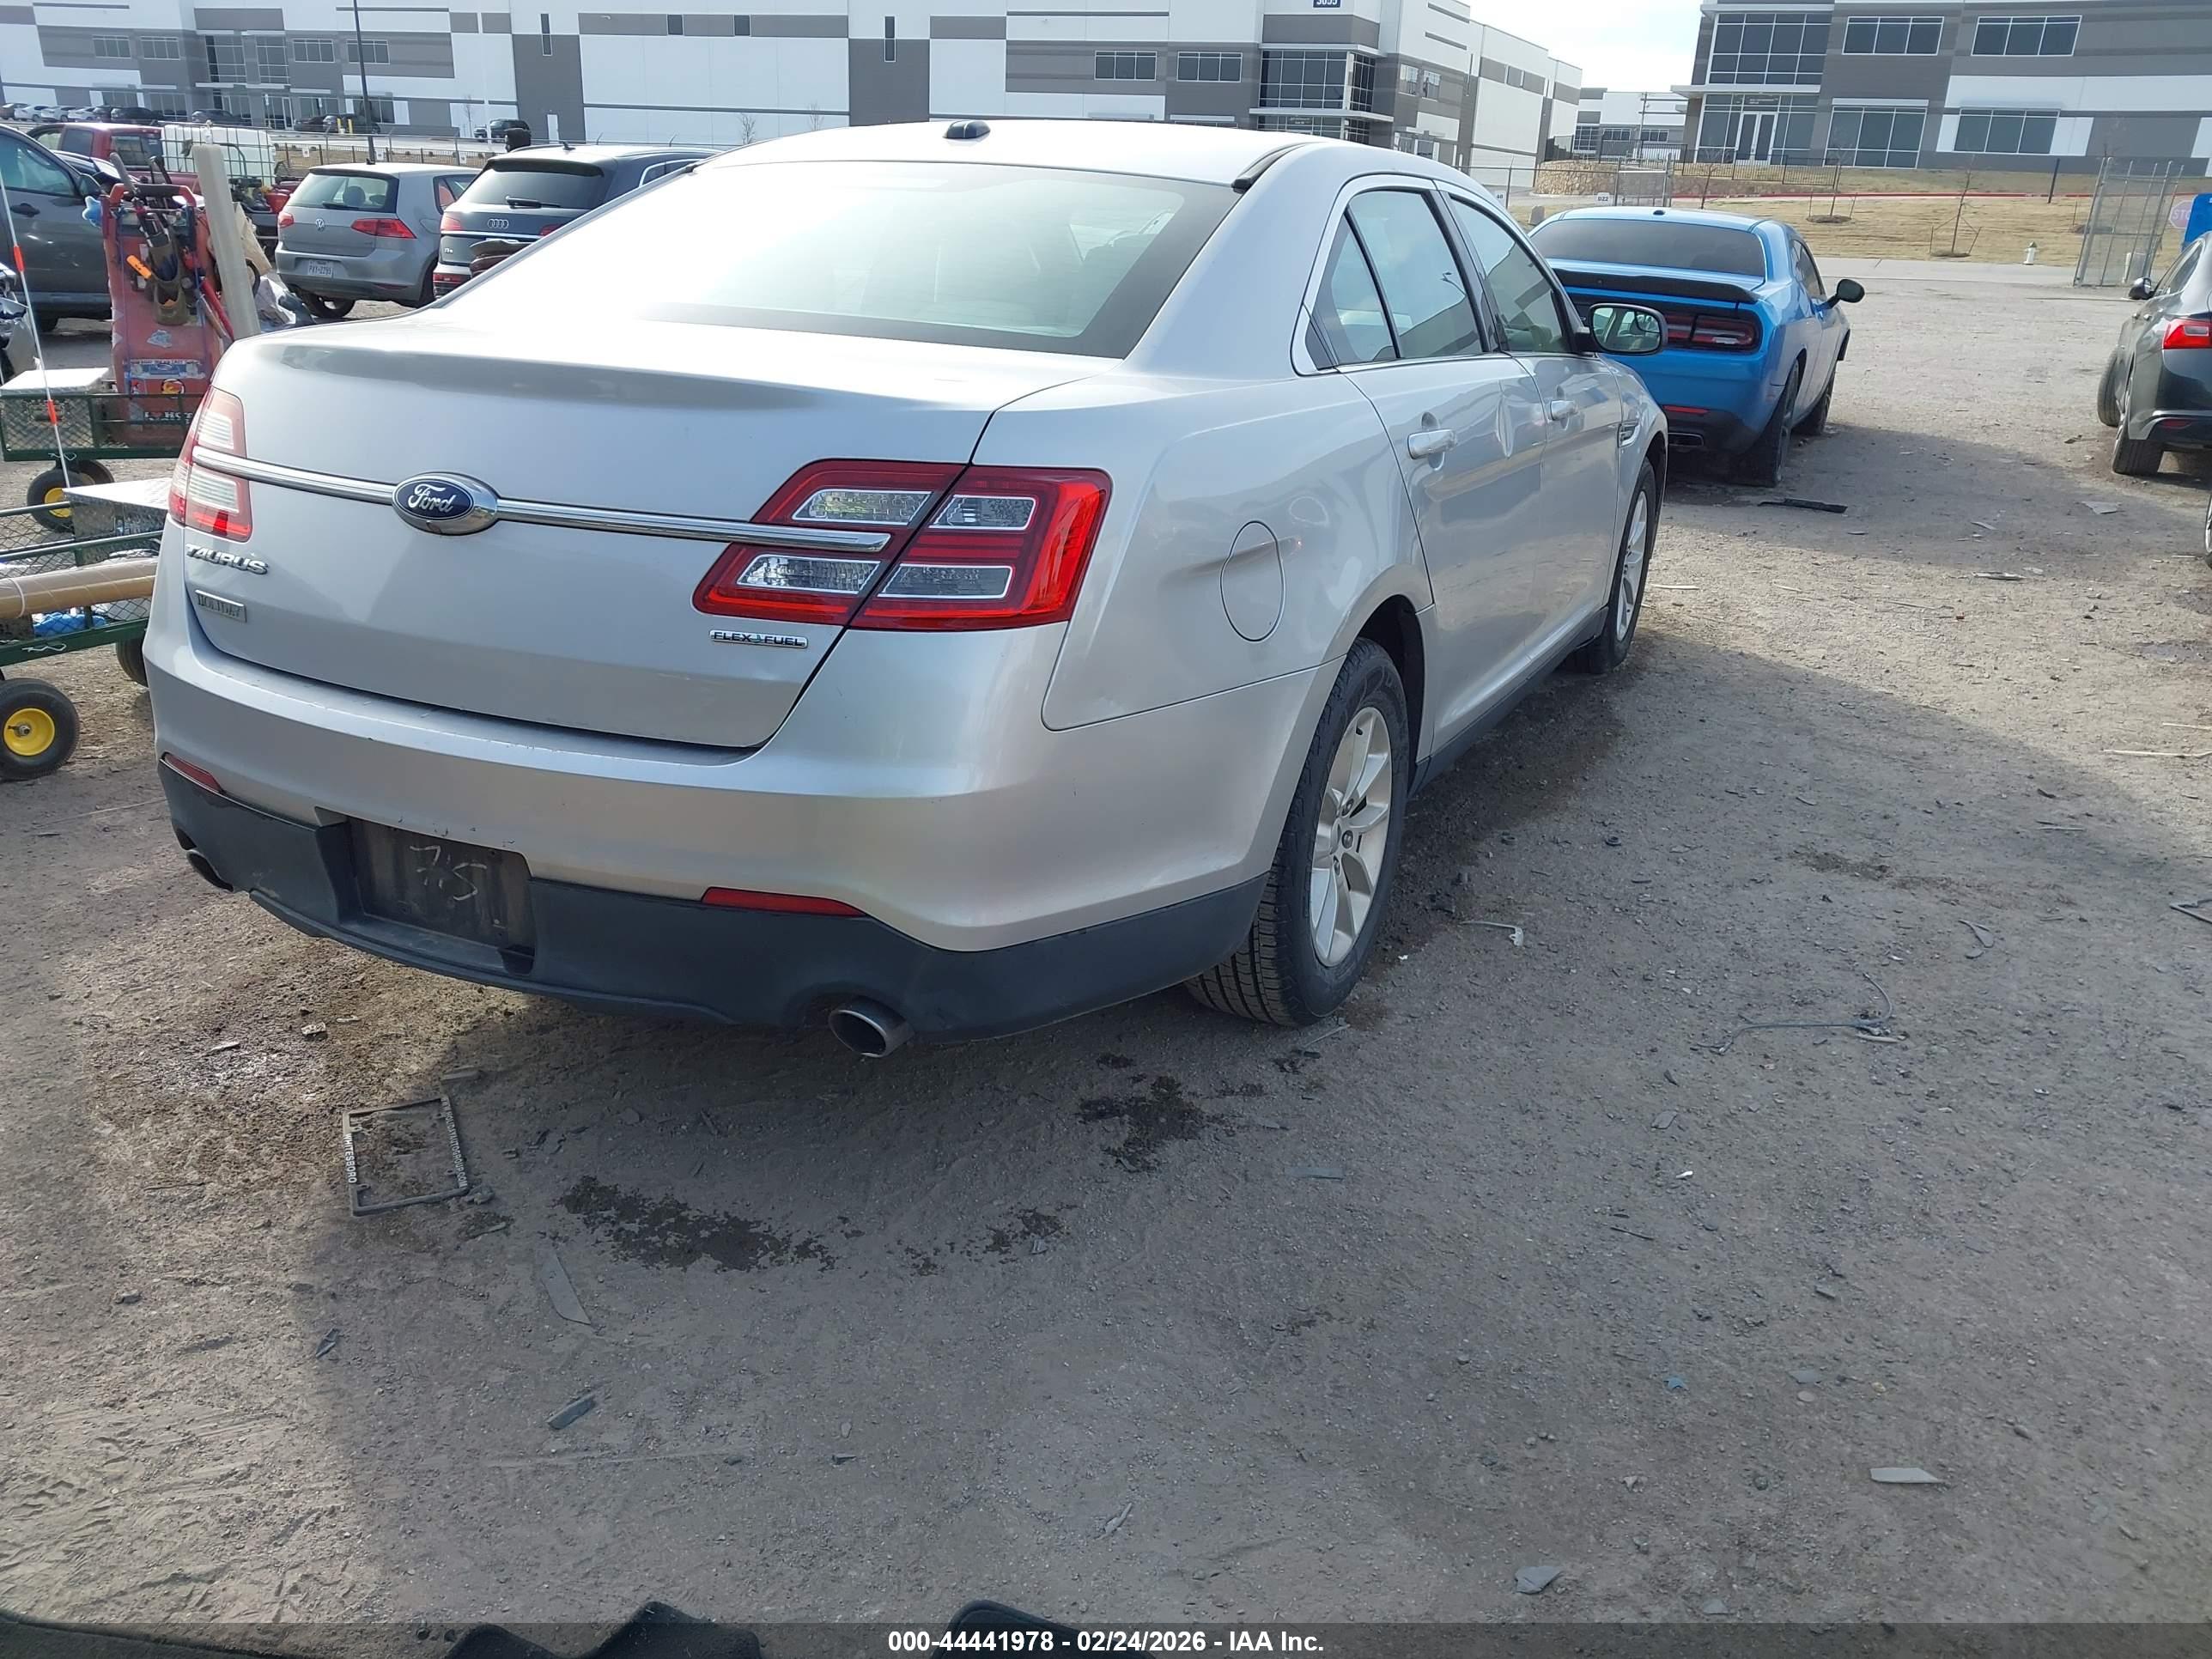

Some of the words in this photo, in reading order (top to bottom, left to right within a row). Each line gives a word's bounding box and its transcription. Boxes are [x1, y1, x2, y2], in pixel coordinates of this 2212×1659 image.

[2172, 210, 2191, 221] STO
[408, 483, 456, 513] Ford
[185, 543, 268, 574] TAURUS
[714, 631, 751, 642] FLEX
[764, 635, 805, 647] FUEL
[343, 1133, 357, 1183] WHITESBORO
